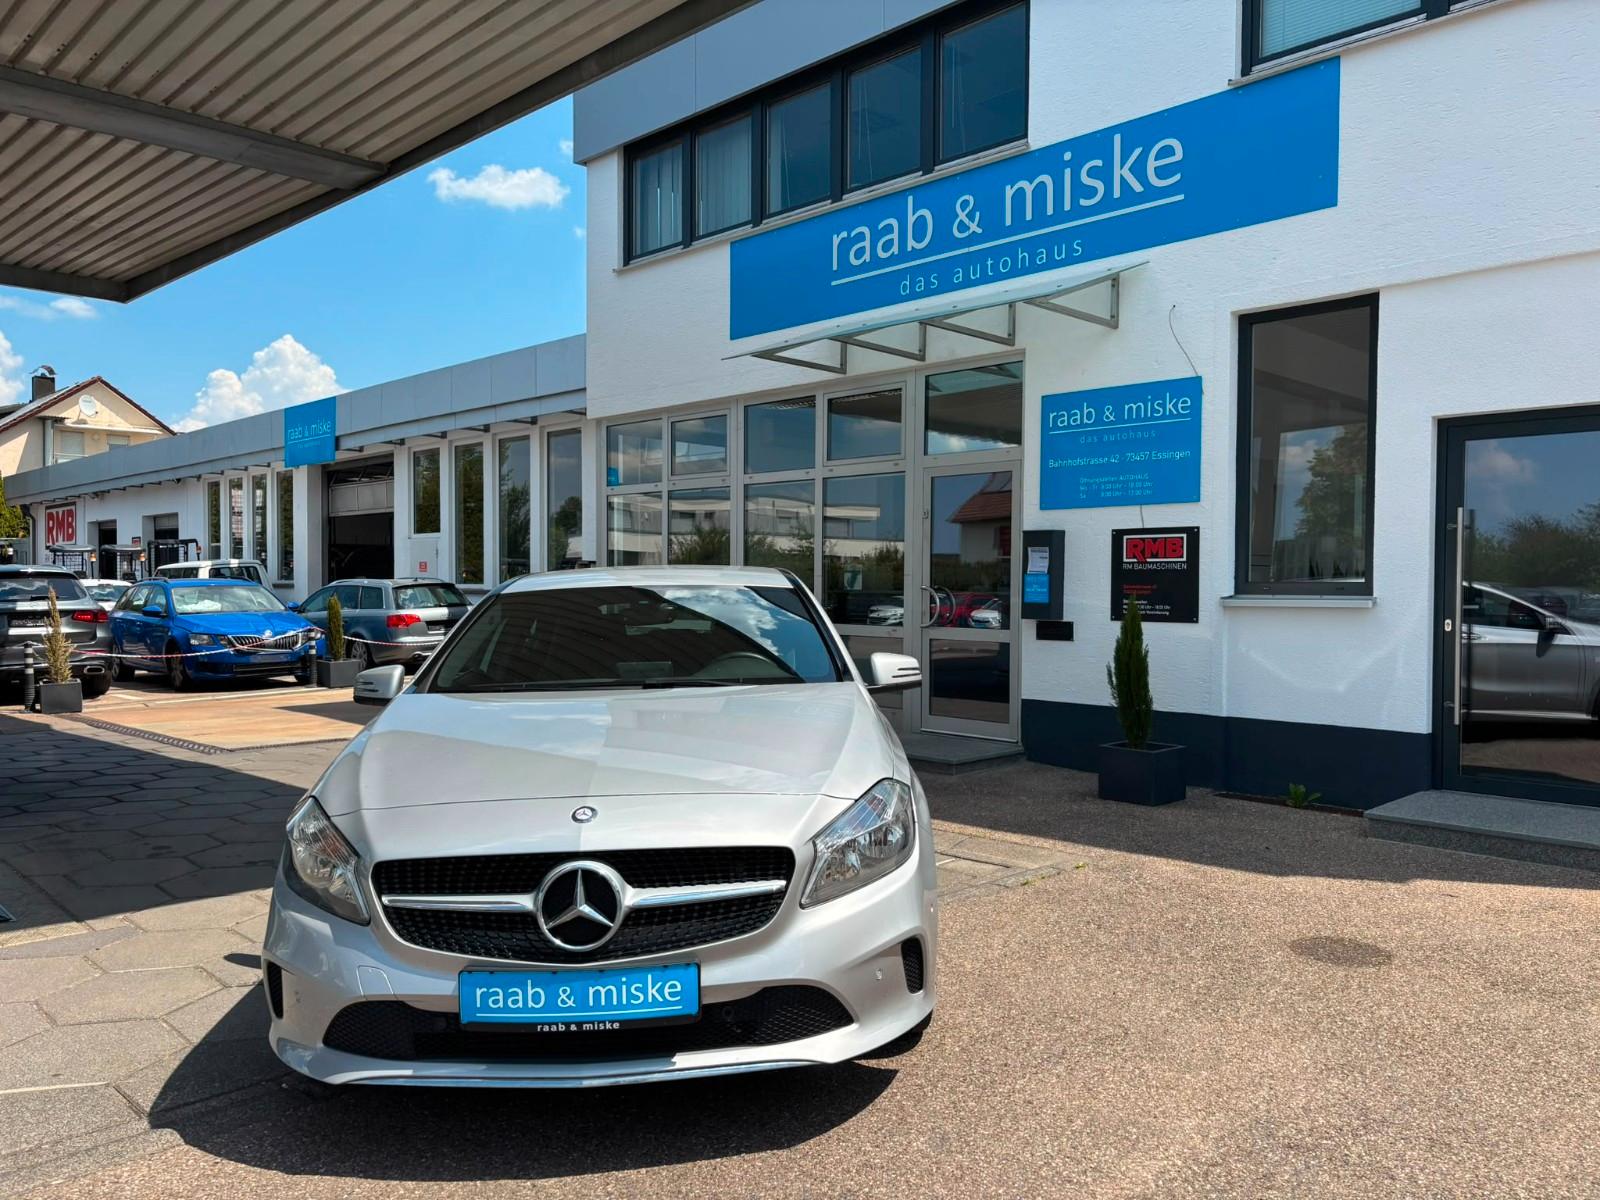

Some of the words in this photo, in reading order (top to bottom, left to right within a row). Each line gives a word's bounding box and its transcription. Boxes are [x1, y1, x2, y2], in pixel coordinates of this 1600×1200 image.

[832, 195, 934, 271] raab
[952, 194, 983, 239] &
[1005, 133, 1184, 227] miske
[900, 274, 938, 296] das
[953, 239, 1083, 283] autohaus
[1049, 402, 1096, 428] raab
[1103, 405, 1116, 422] &
[1124, 392, 1191, 420] miske
[287, 425, 303, 441] raab
[310, 418, 331, 437] miske
[1079, 434, 1098, 444] das
[1103, 430, 1156, 443] autohaus
[1048, 456, 1108, 469] Bahnhofstrasse
[1110, 454, 1120, 464] 42
[1126, 451, 1150, 462] 73457
[1151, 449, 1191, 461] Essingen
[46, 508, 76, 546] RMB
[1126, 537, 1184, 564] RMB
[1134, 562, 1187, 570] BAUMASCHINEN
[475, 979, 546, 1009] raab
[557, 986, 576, 1008] &
[588, 974, 682, 1006] miske
[537, 1022, 566, 1032] raab
[570, 1023, 577, 1031] &
[583, 1020, 620, 1031] miske
